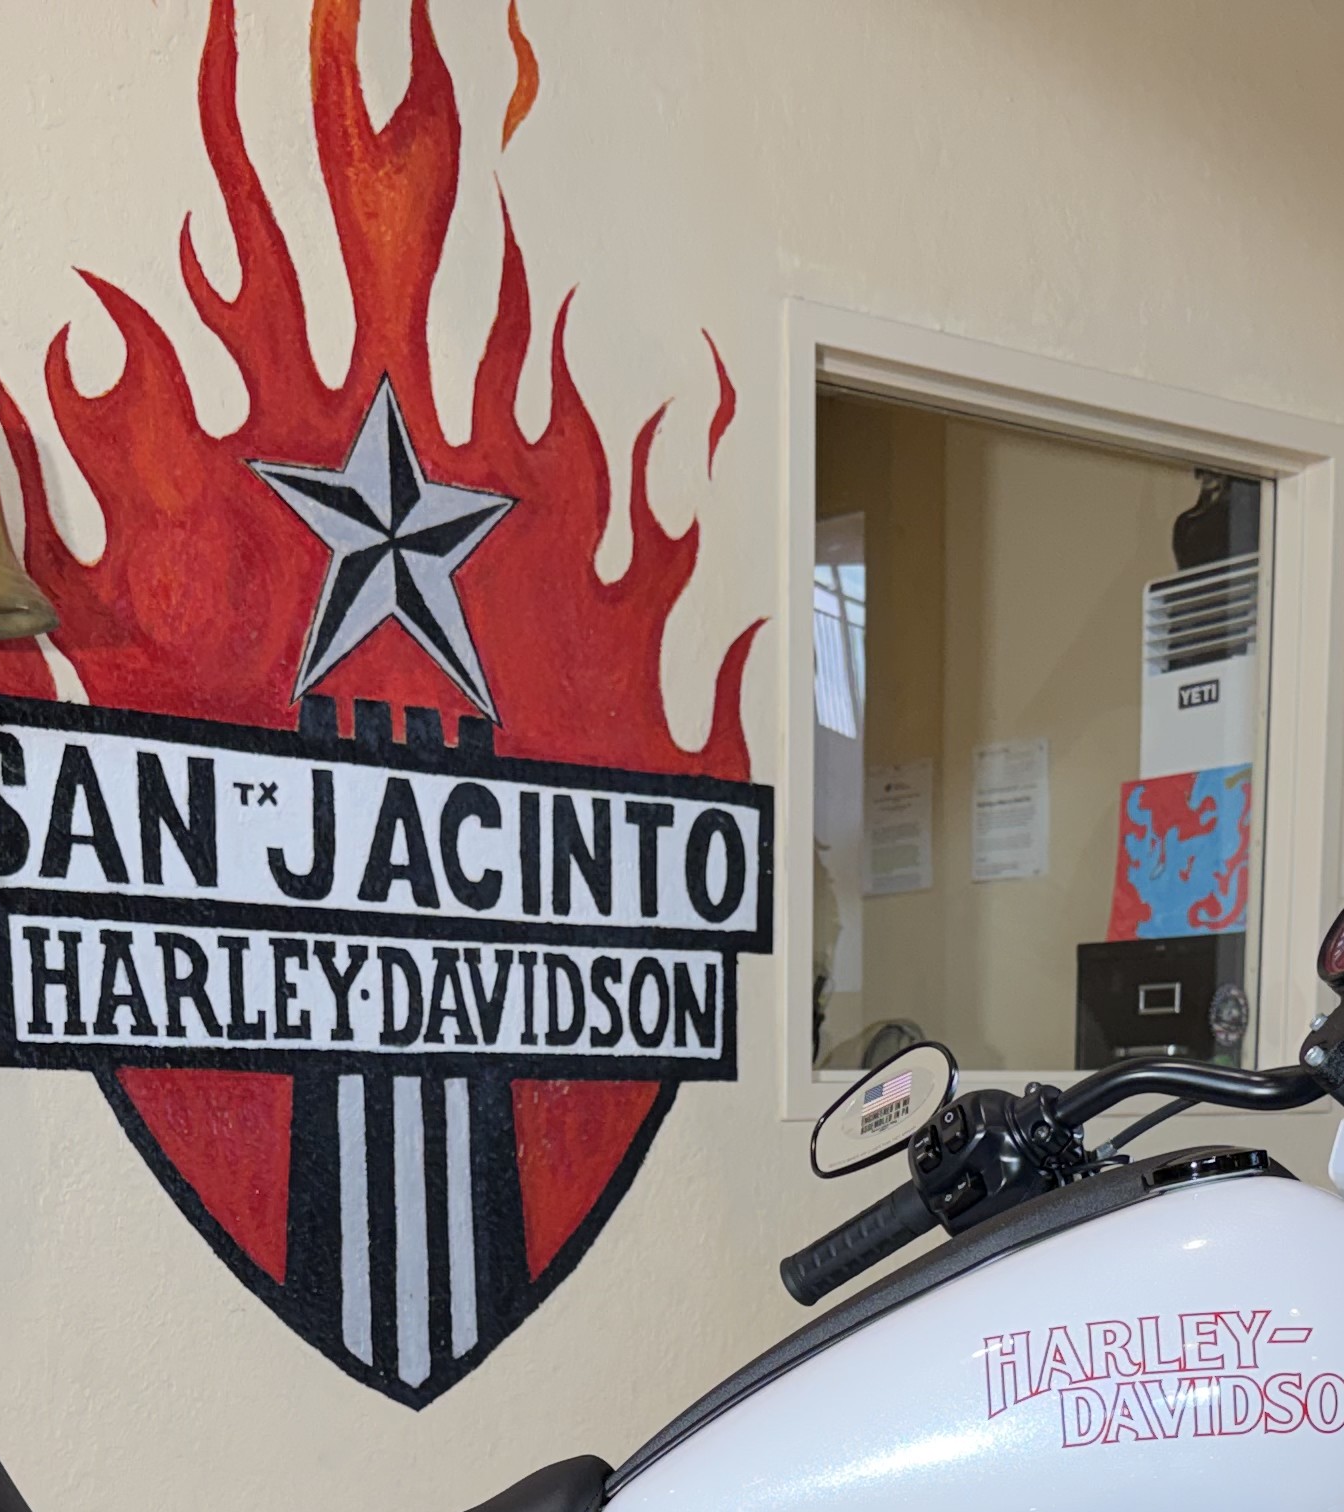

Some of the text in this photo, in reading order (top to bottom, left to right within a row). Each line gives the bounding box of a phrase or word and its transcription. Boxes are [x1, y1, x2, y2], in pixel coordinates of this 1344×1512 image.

[1180, 683, 1216, 706] YETI
[233, 780, 278, 809] TX
[267, 769, 747, 925] JACINTO
[983, 1310, 1313, 1420] HARLEY-
